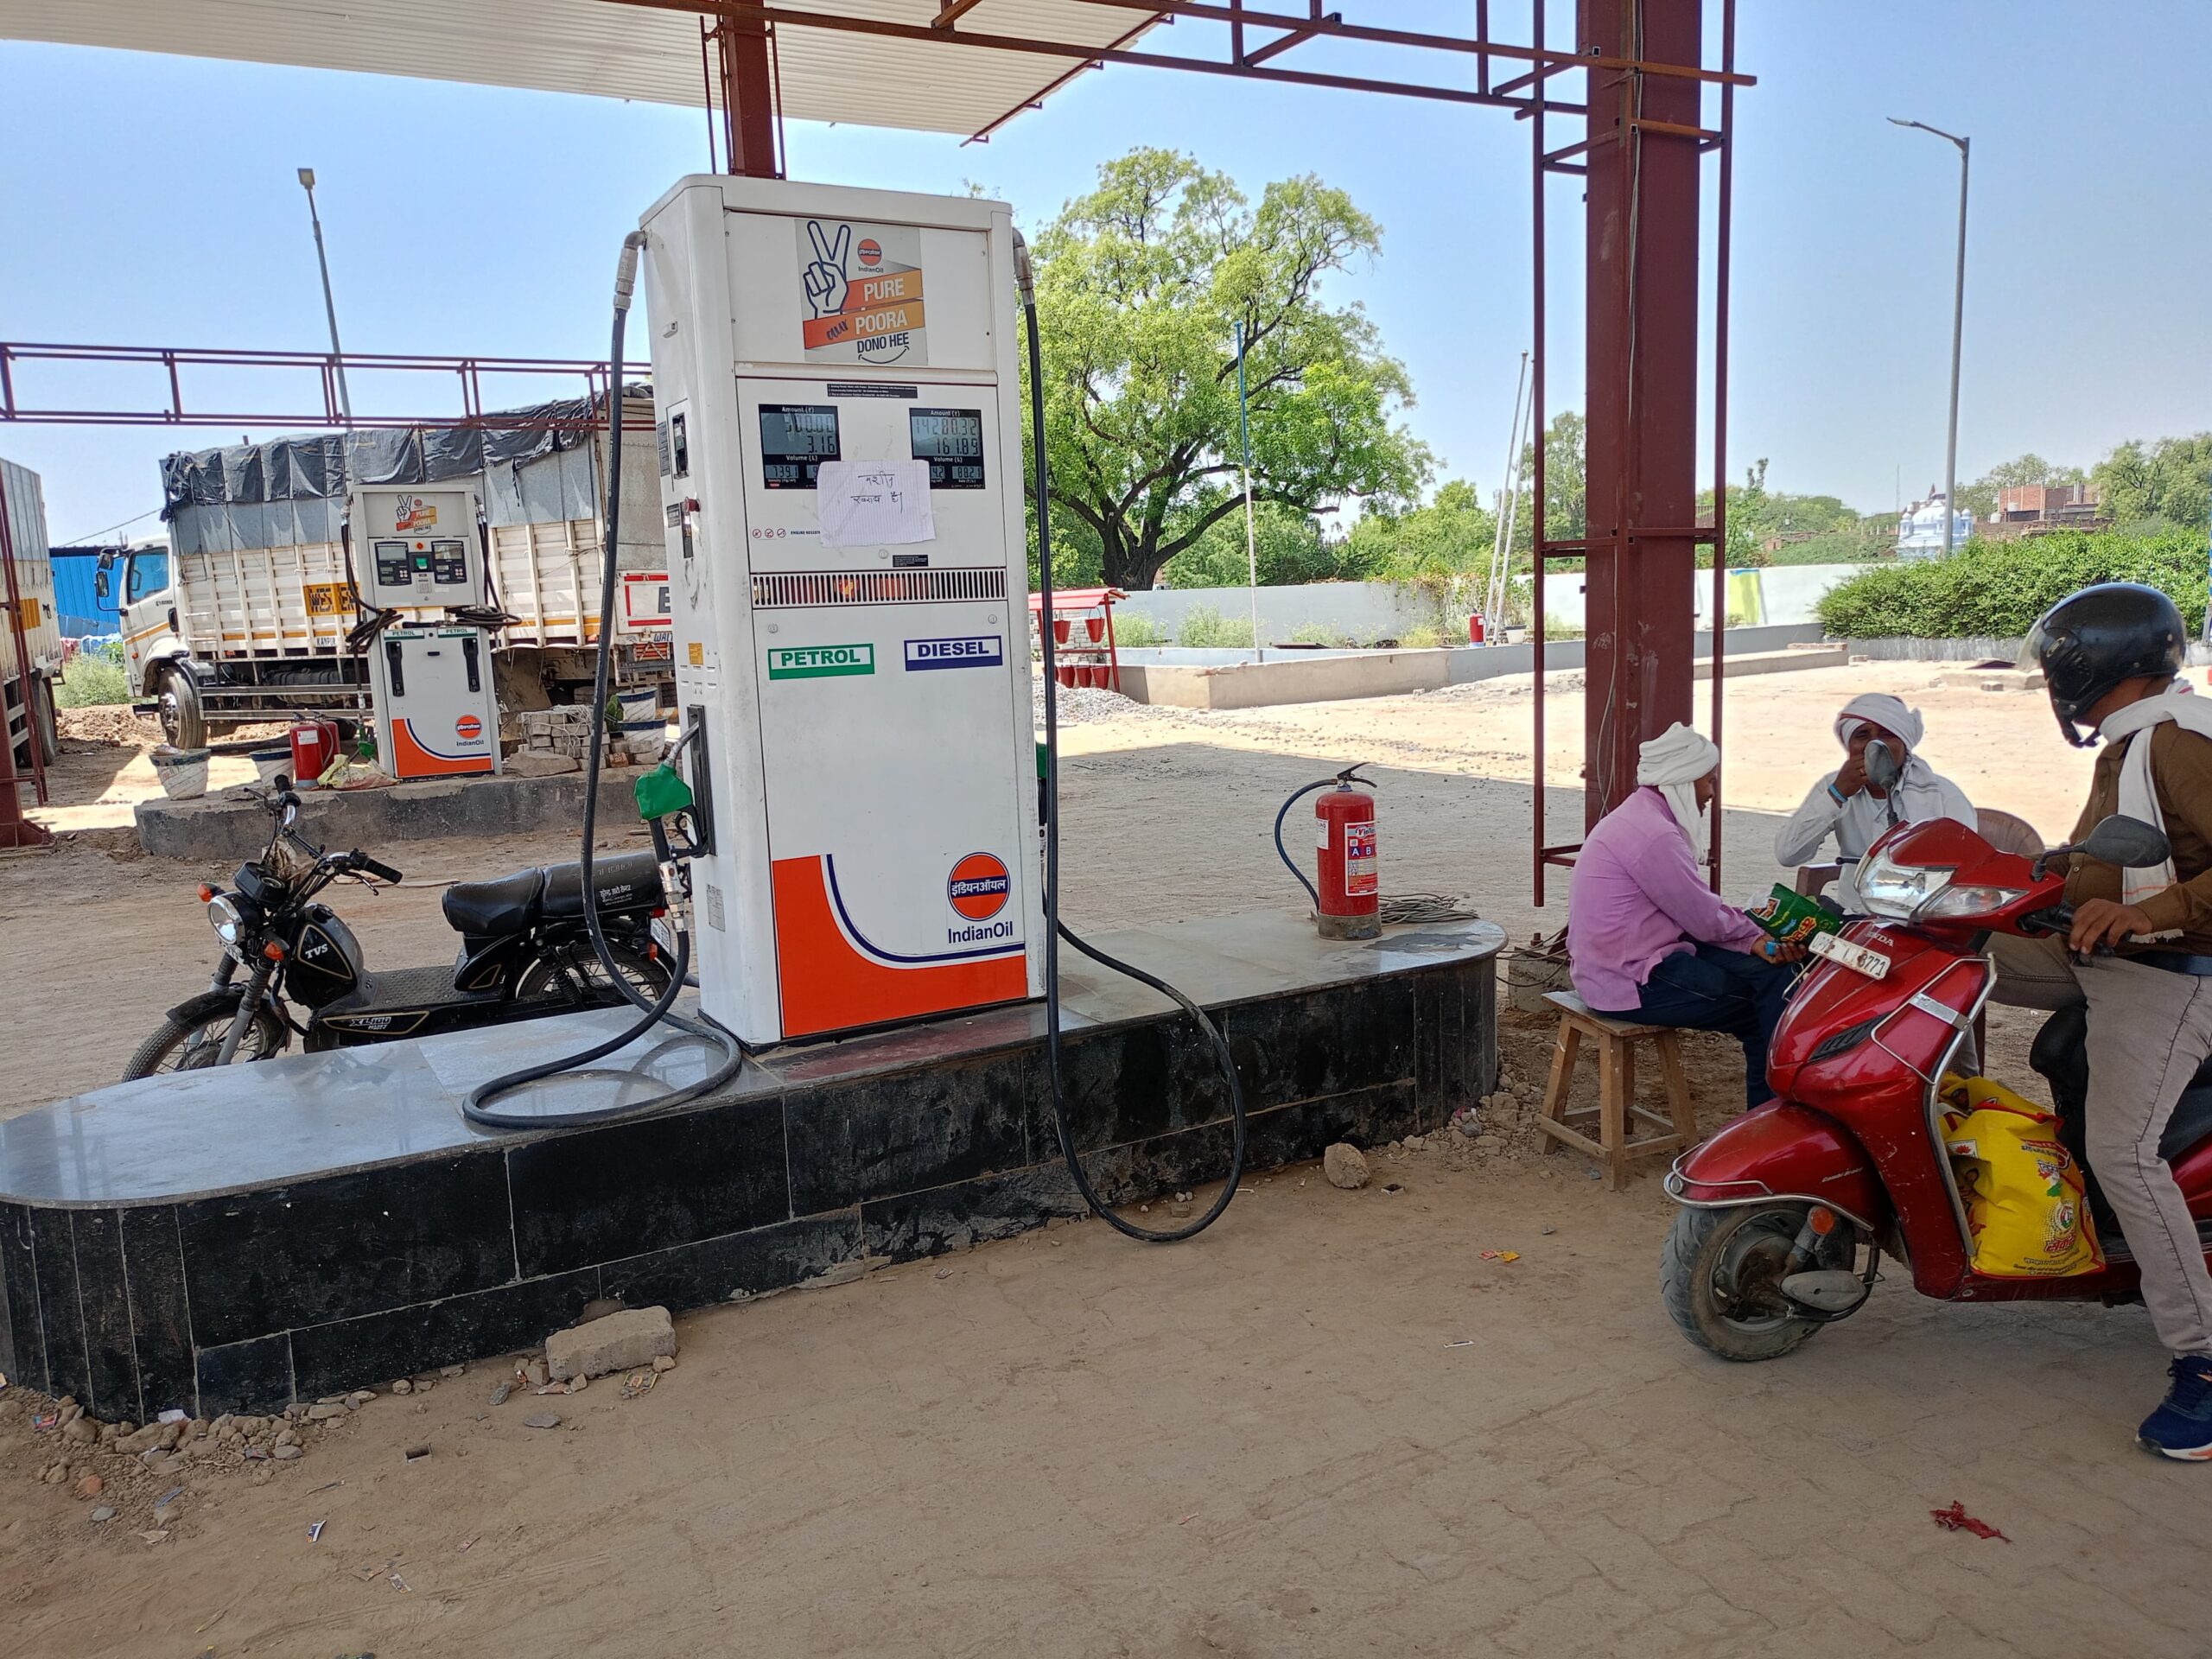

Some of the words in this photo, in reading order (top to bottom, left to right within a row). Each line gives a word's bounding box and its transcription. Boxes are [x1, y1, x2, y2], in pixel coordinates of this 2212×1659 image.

[864, 278, 905, 302] PURE
[855, 309, 907, 335] POORA
[857, 335, 887, 354] DONO
[889, 332, 910, 346] HEE
[807, 435, 835, 453] 3.16
[780, 648, 861, 666] PETROL
[917, 641, 990, 658] DIESEL
[1352, 848, 1359, 856] A
[951, 879, 1007, 897] इंडियनऑयल
[948, 921, 1014, 944] IndianOil
[305, 944, 328, 959] TVS
